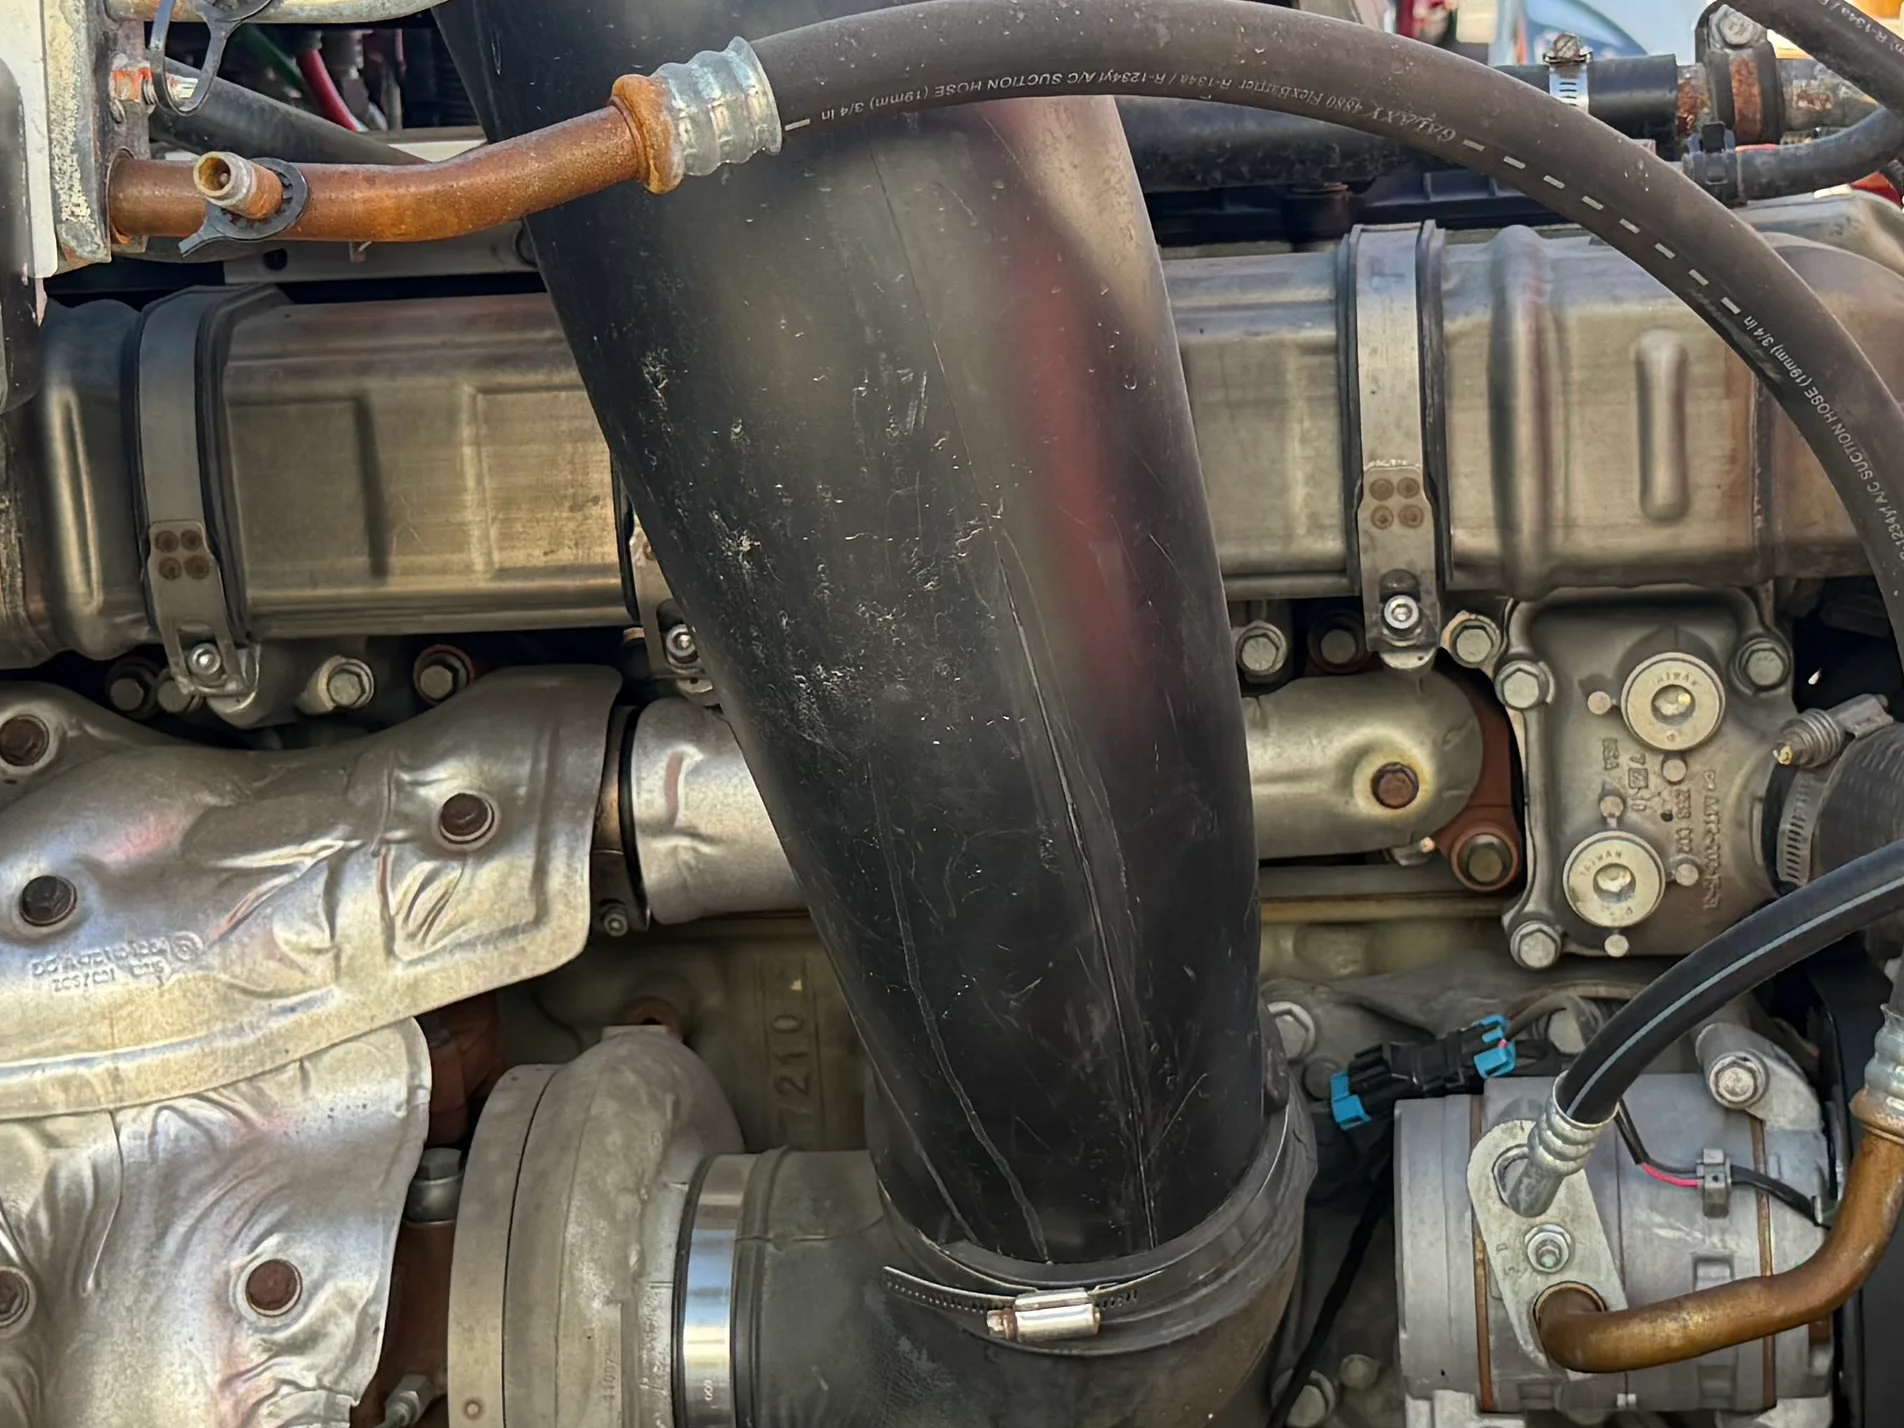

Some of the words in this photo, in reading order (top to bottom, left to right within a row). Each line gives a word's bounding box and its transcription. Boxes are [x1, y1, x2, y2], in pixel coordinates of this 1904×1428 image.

[987, 72, 1063, 90] SUCTION
[1067, 71, 1094, 84] A/C
[870, 87, 929, 111] (19mm)
[934, 80, 982, 98] HOSE
[840, 101, 865, 118] 3/4
[1754, 327, 1774, 346] 3/4
[1769, 344, 1814, 388] (19mm)
[1804, 386, 1838, 424] HOSE
[1832, 424, 1874, 481] SUCTION
[1867, 481, 1888, 504] A/C
